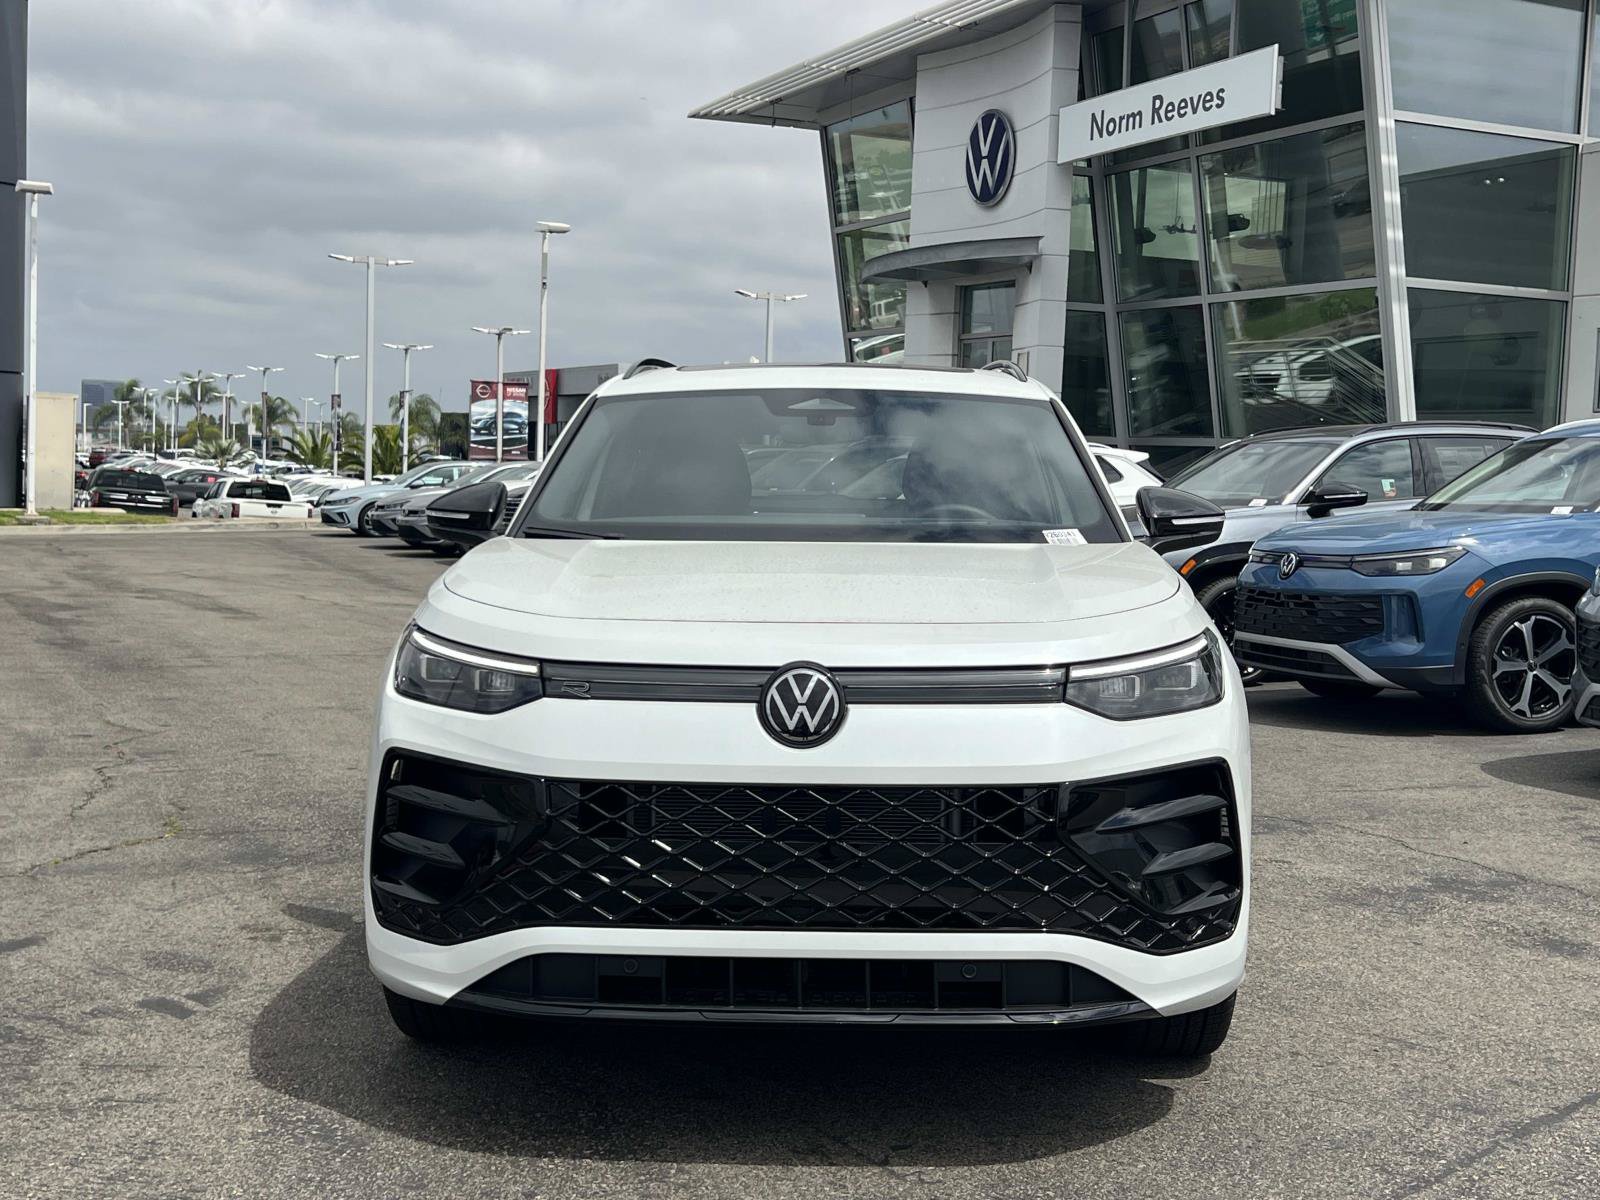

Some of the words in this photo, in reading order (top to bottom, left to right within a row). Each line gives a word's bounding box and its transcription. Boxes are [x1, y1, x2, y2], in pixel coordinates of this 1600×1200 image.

[1090, 109, 1143, 140] Norm
[1150, 87, 1226, 125] Reeves
[966, 111, 1012, 203] VW
[1280, 553, 1296, 577] VW
[765, 667, 839, 739] VW
